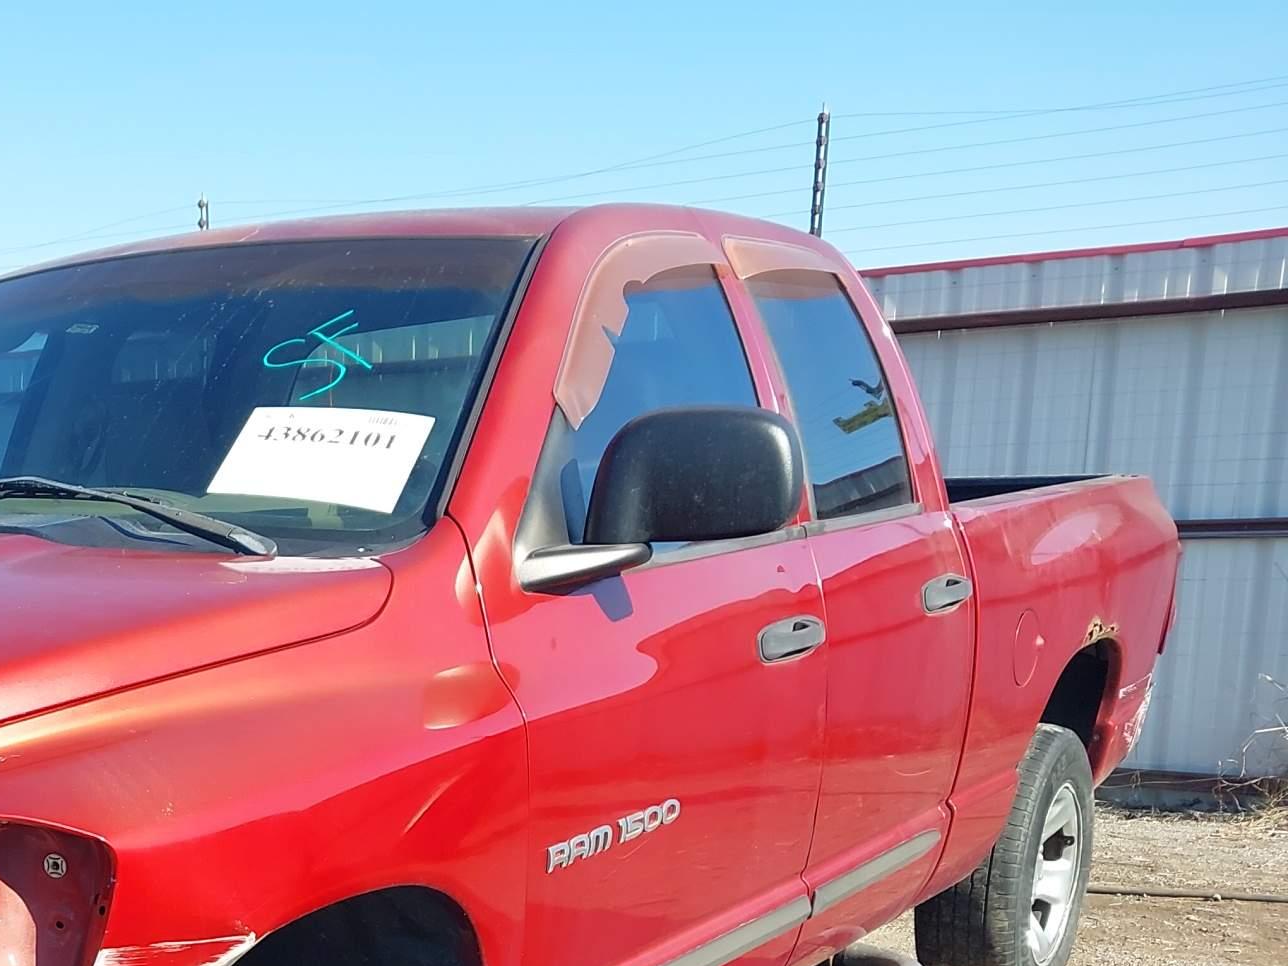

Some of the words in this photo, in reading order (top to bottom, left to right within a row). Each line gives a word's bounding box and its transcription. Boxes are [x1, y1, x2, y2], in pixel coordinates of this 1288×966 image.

[257, 425, 397, 449] 43862101
[545, 824, 613, 874] RAM
[617, 798, 681, 844] 1500
